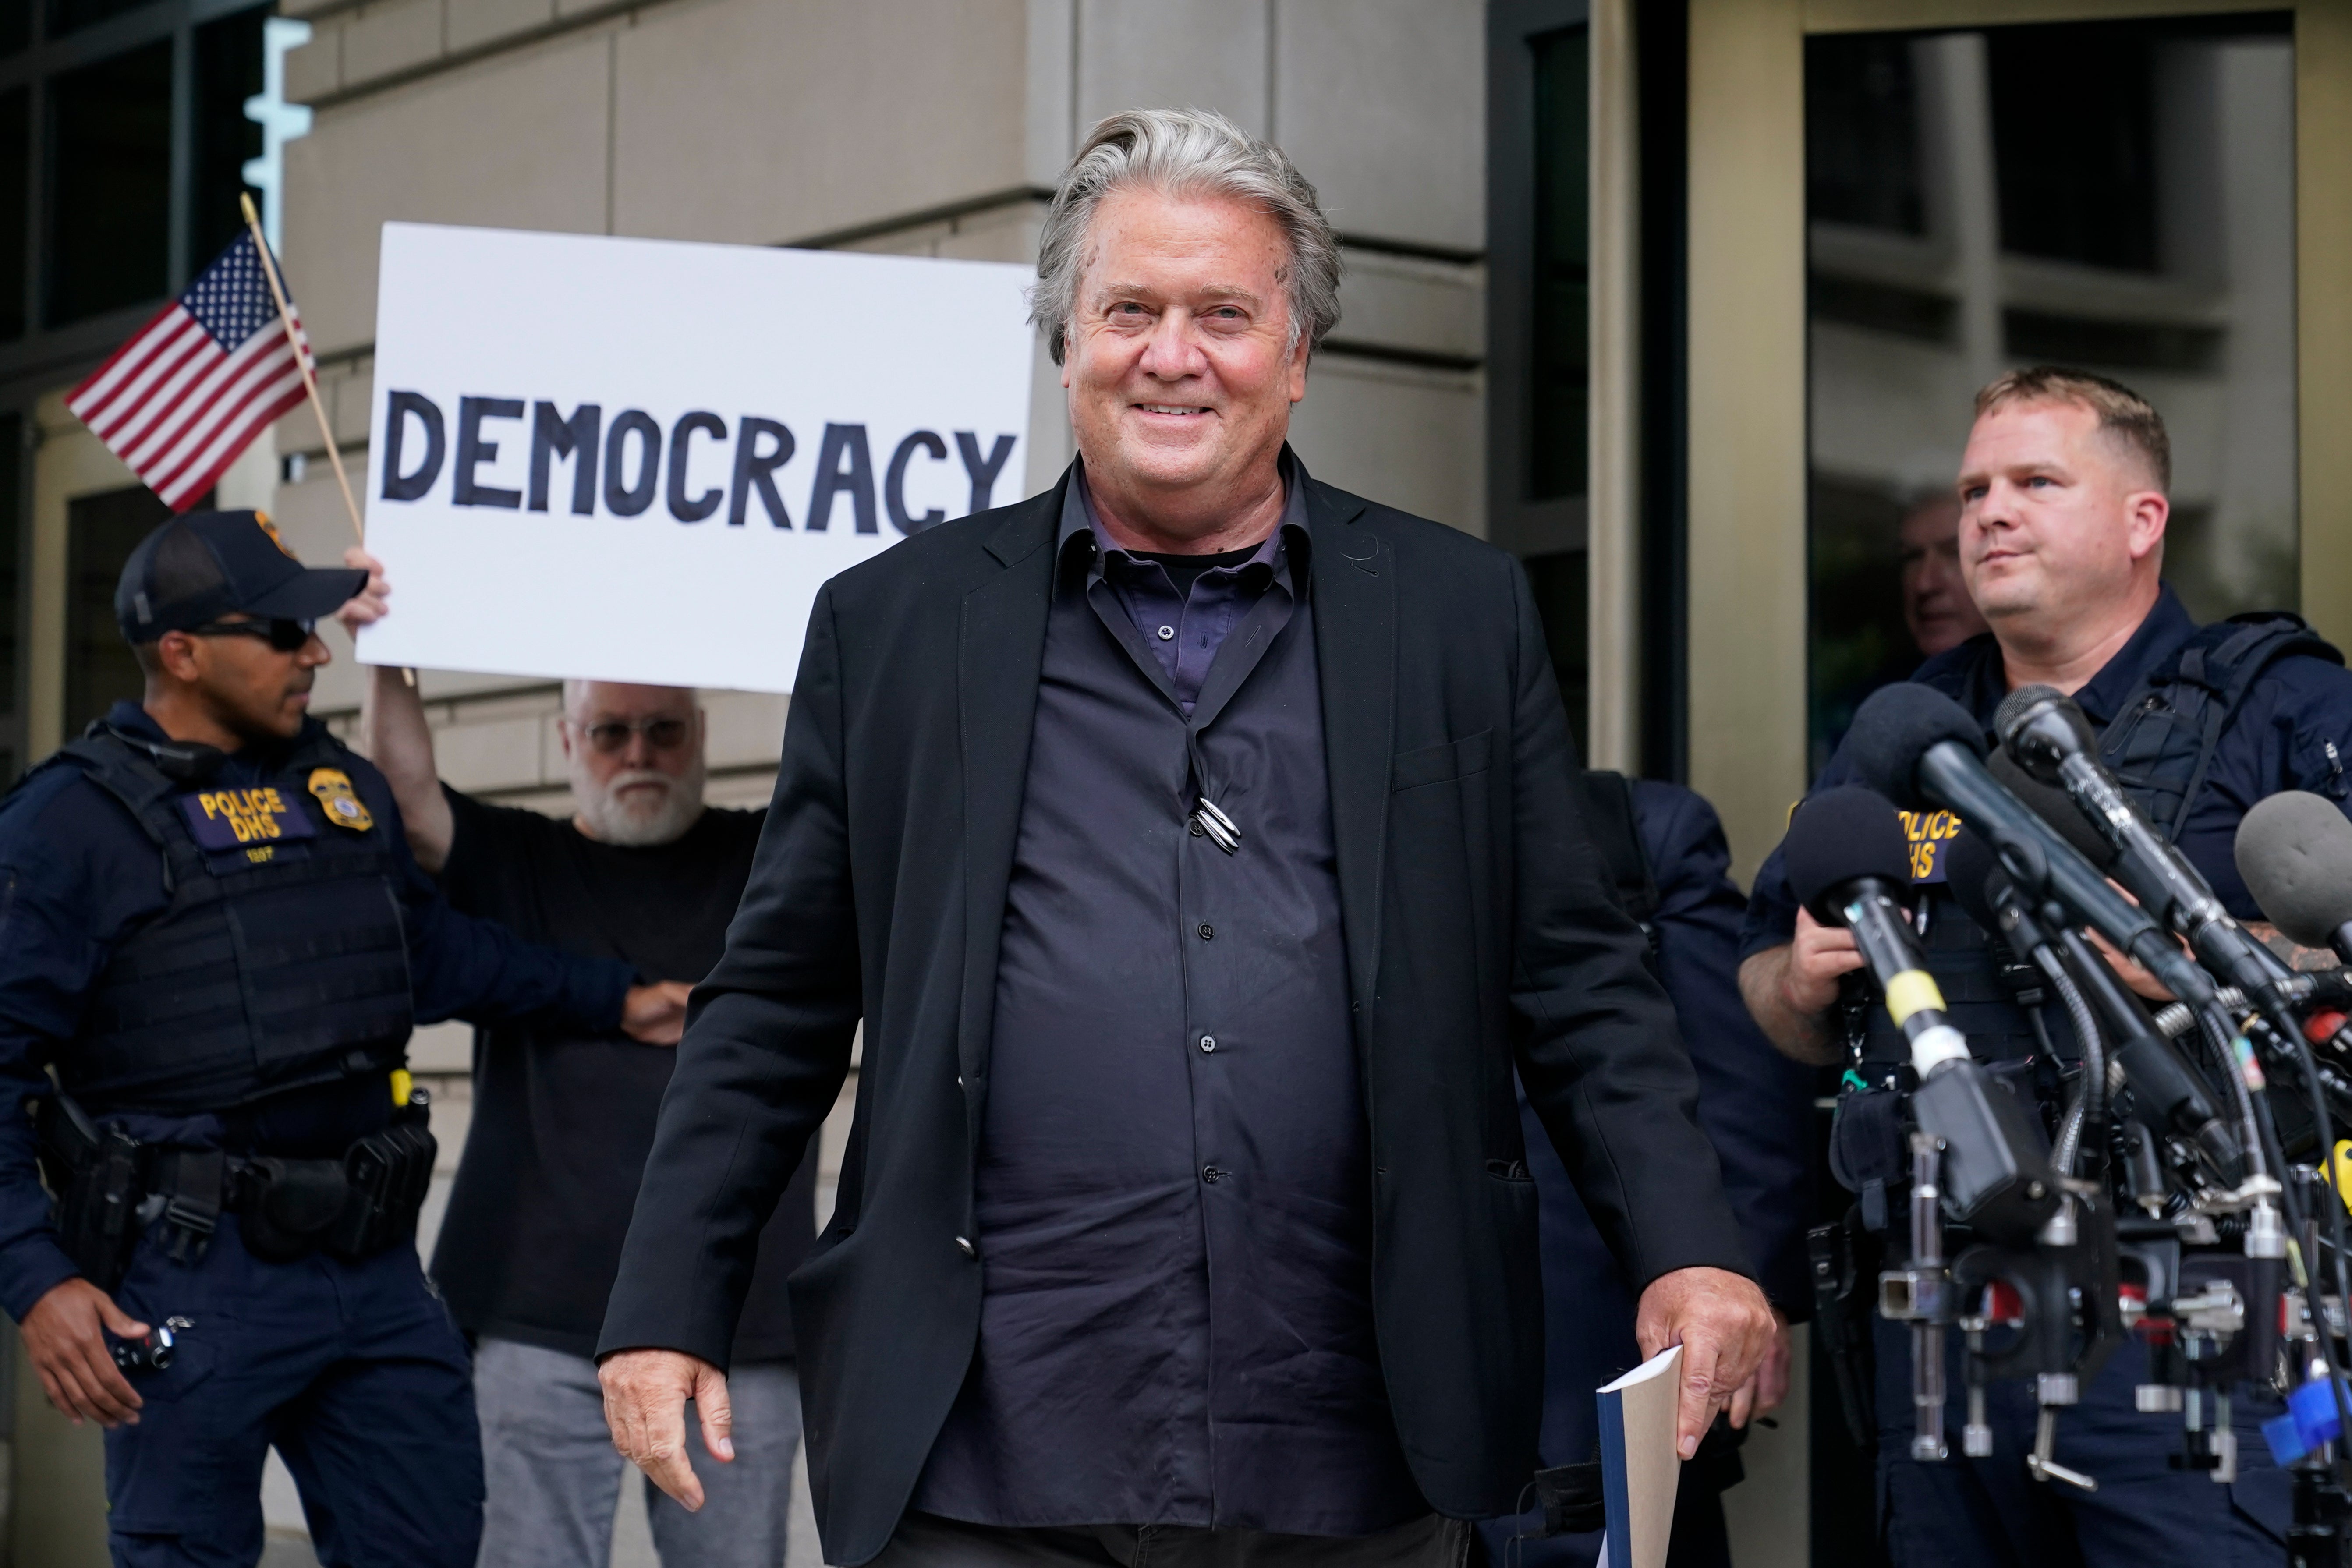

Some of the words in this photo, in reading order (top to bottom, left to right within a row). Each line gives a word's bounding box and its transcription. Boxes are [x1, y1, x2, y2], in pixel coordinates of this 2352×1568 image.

[380, 389, 1018, 537] DEMOCRACY
[198, 788, 287, 820] POLICE
[229, 814, 281, 842] DHS
[1898, 809, 1962, 841] OLICE
[1909, 842, 1936, 879] HS
